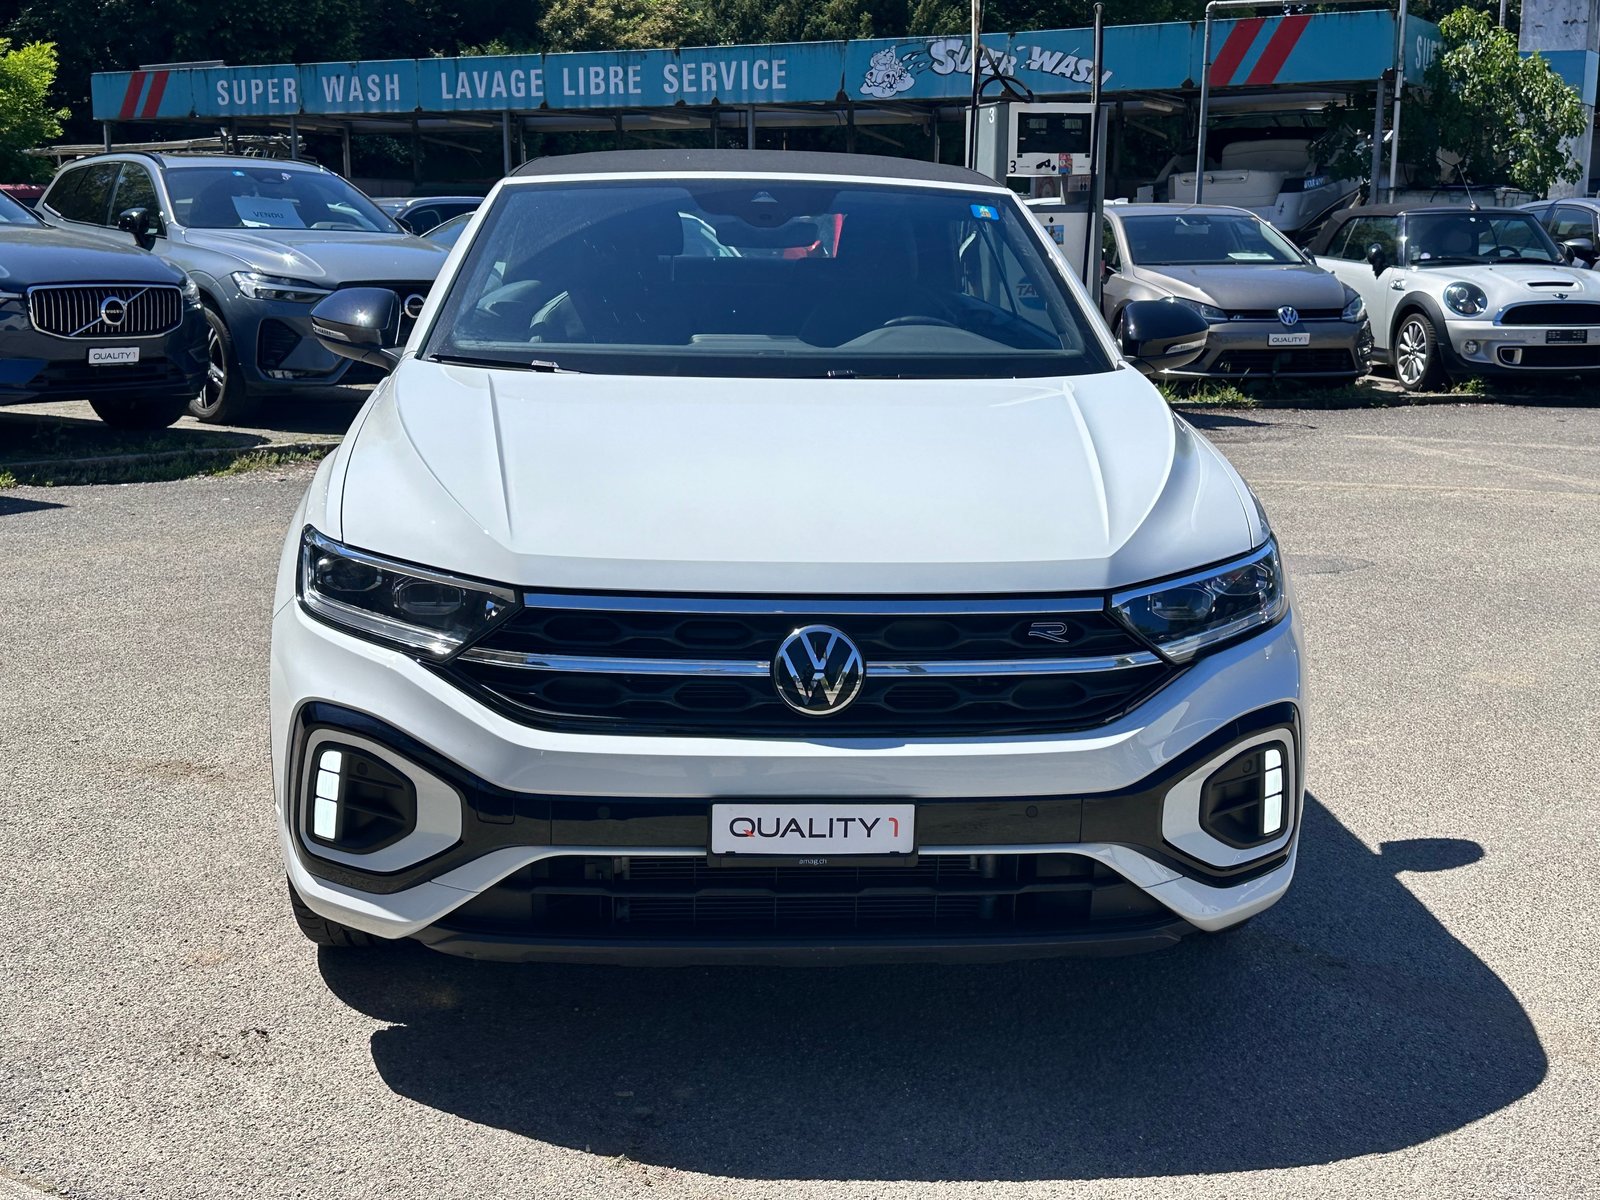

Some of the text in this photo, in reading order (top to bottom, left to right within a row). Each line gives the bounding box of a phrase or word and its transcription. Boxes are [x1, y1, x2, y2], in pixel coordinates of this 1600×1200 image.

[1415, 35, 1446, 71] SUP
[217, 59, 787, 106] SUPER WASH LAVAGE LIBRE SERVICE
[988, 107, 995, 124] 3
[1009, 160, 1017, 174] 3
[253, 211, 284, 219] VENDU
[93, 351, 131, 360] QUALITY
[729, 817, 899, 838] QUALITY 1
[799, 858, 828, 866] amag.ch
